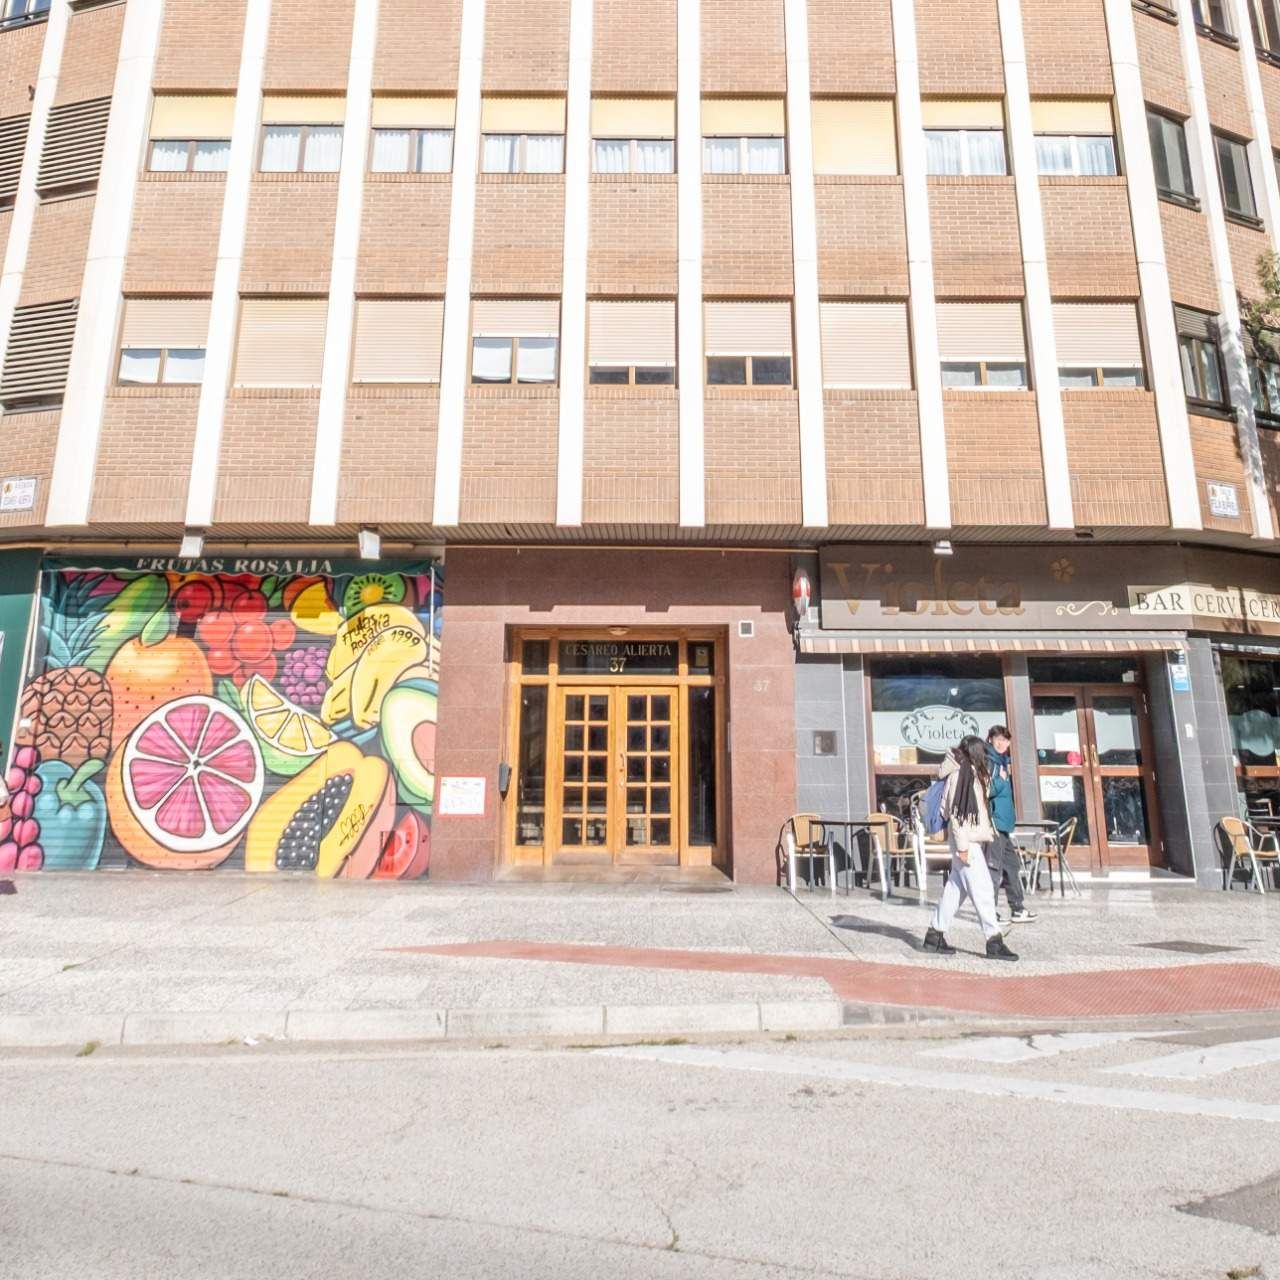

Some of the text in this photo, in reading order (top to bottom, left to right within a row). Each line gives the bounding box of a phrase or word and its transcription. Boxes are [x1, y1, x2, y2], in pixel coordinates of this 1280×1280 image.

[136, 558, 334, 573] FRUTAS ROSALIA
[826, 558, 1026, 616] Violeta
[1135, 591, 1185, 612] BAR
[390, 629, 422, 648] 1999
[565, 643, 671, 656] CESAREO ALIERTA
[609, 657, 627, 673] 37
[915, 723, 966, 740] Violeta
